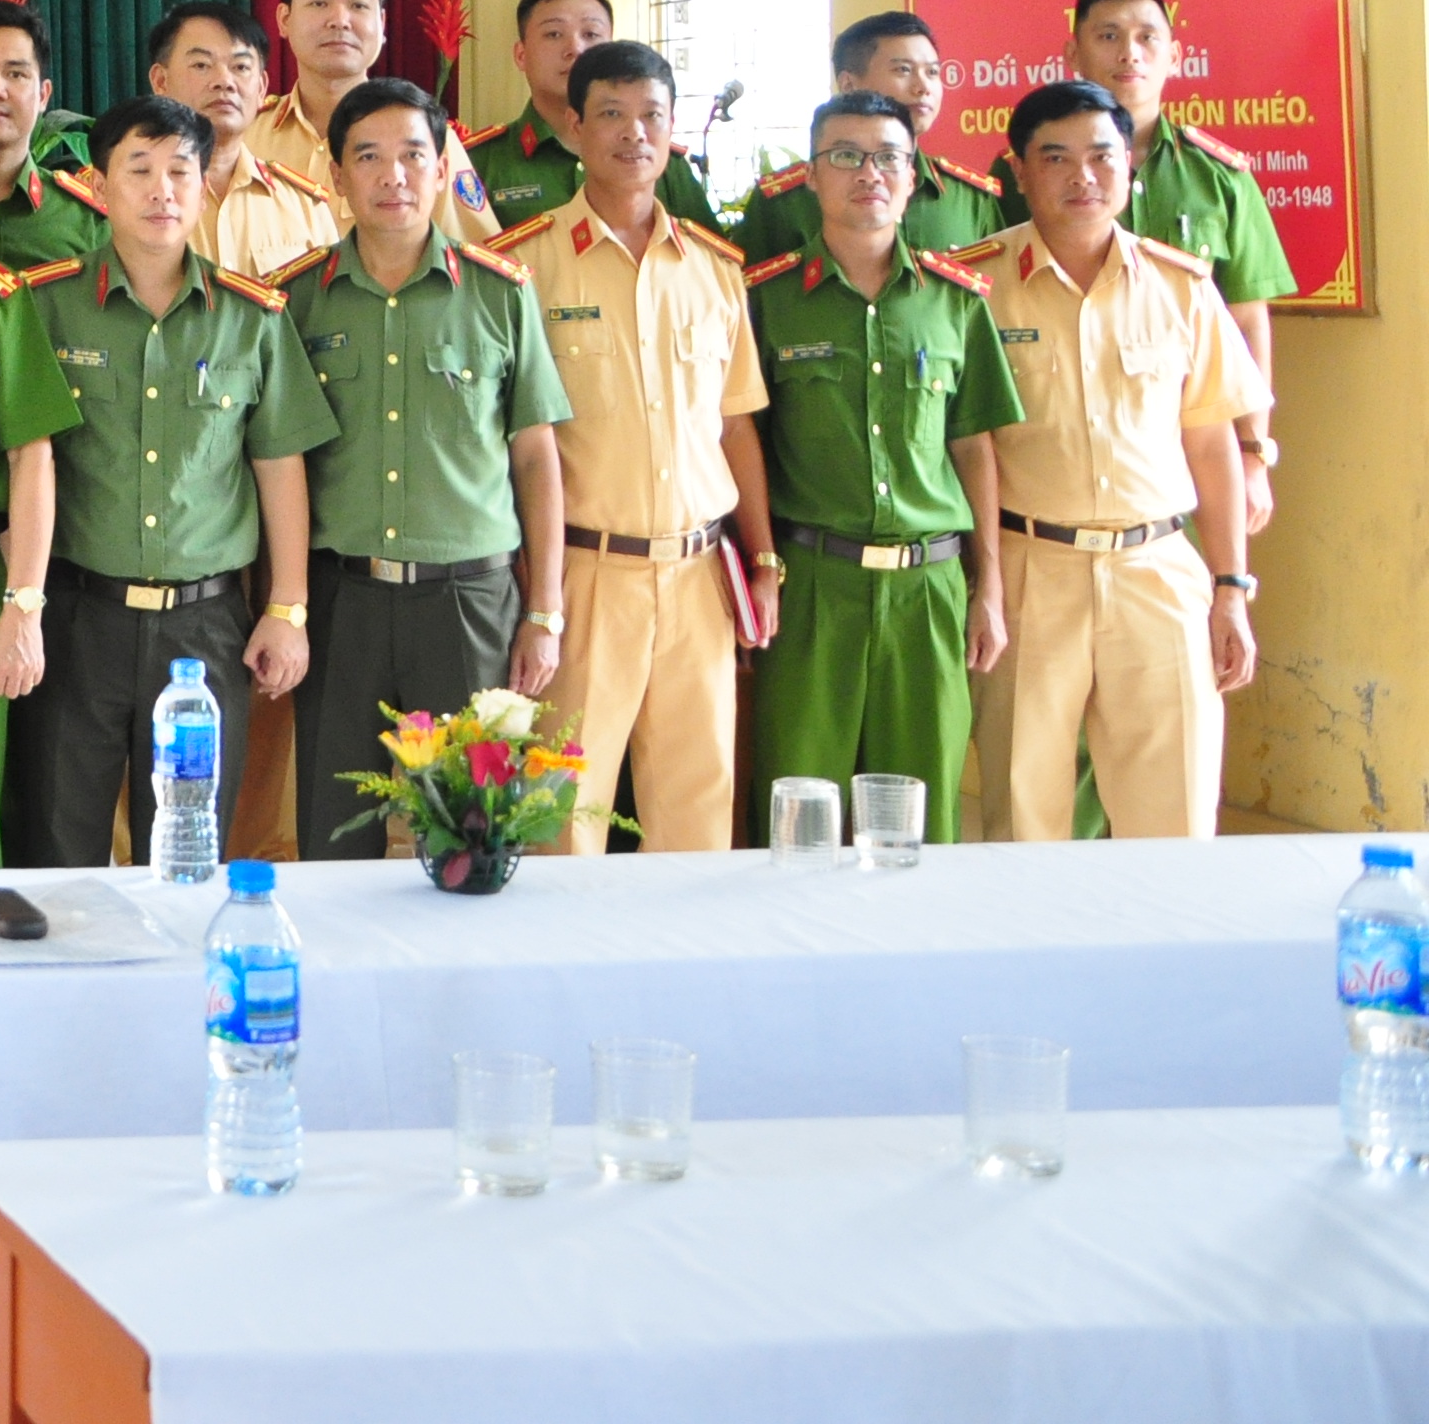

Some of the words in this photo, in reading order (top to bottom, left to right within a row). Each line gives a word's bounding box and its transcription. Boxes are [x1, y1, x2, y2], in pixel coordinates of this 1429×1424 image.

[974, 54, 1017, 87] Đối
[1026, 56, 1064, 85] với
[960, 105, 1011, 134] CƯƠ
[1234, 91, 1313, 124] KHÉO.
[1267, 152, 1307, 170] Minh
[1266, 185, 1332, 207] 03-1948
